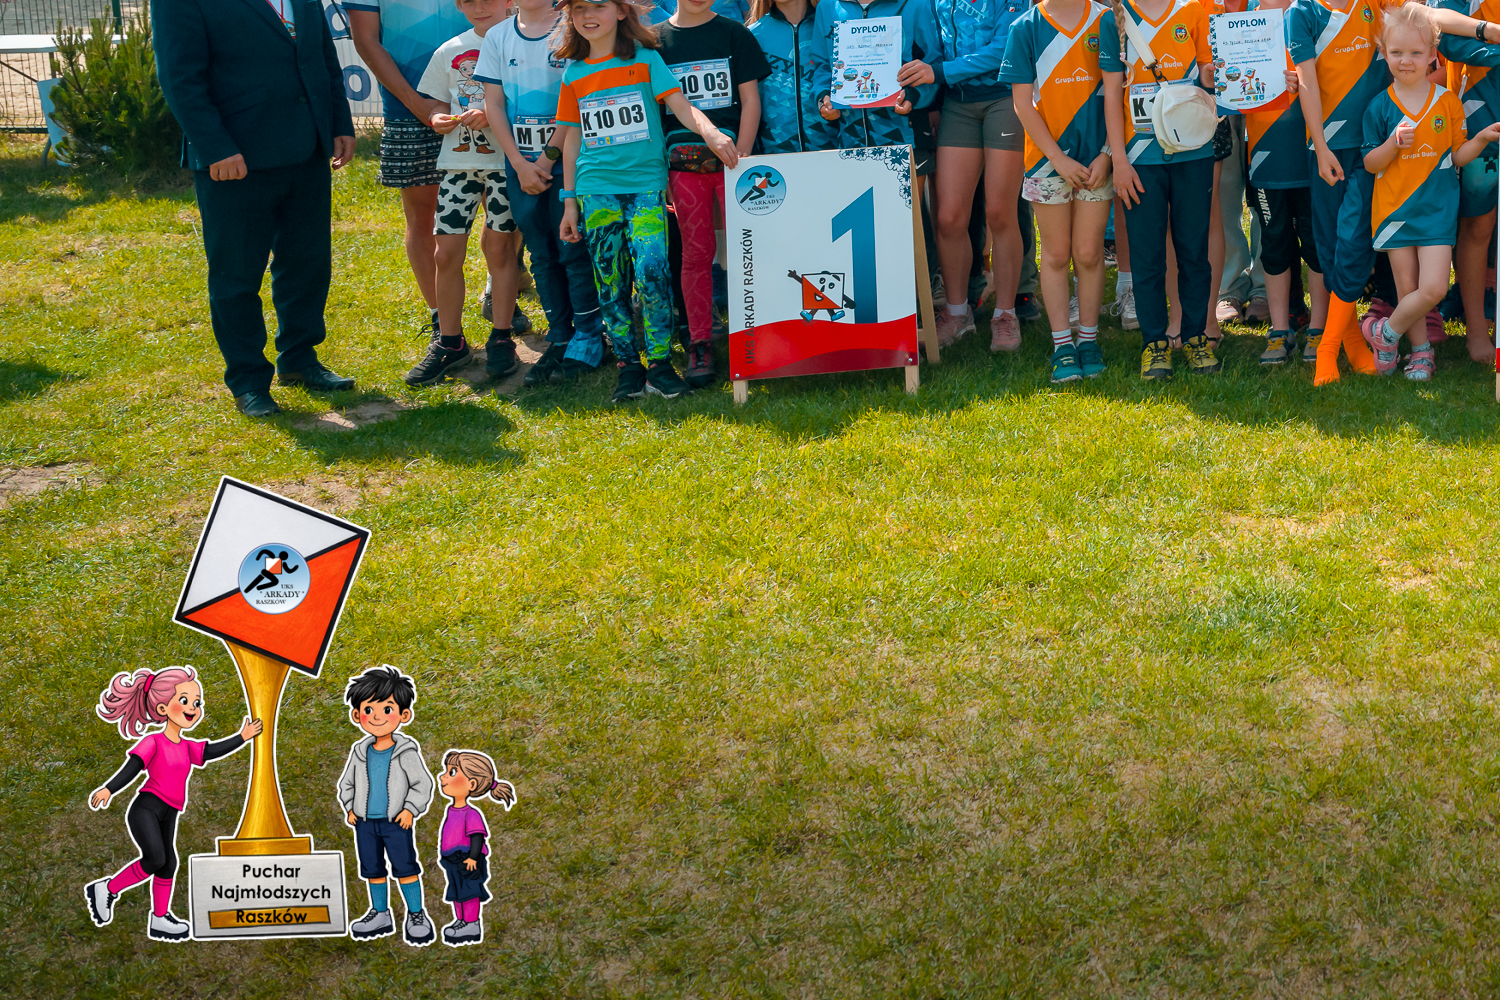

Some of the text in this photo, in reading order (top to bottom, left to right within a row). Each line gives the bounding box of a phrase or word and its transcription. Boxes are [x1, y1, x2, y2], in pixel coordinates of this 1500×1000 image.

[851, 25, 886, 34] DYPLOM
[1228, 18, 1266, 29] DYPLOM
[679, 72, 729, 94] 10 03
[582, 104, 644, 131] K 10 03
[1133, 97, 1147, 117] K
[517, 127, 532, 145] M
[831, 186, 878, 324] 1
[742, 228, 756, 364] UKS ARKADY RASZKÓW
